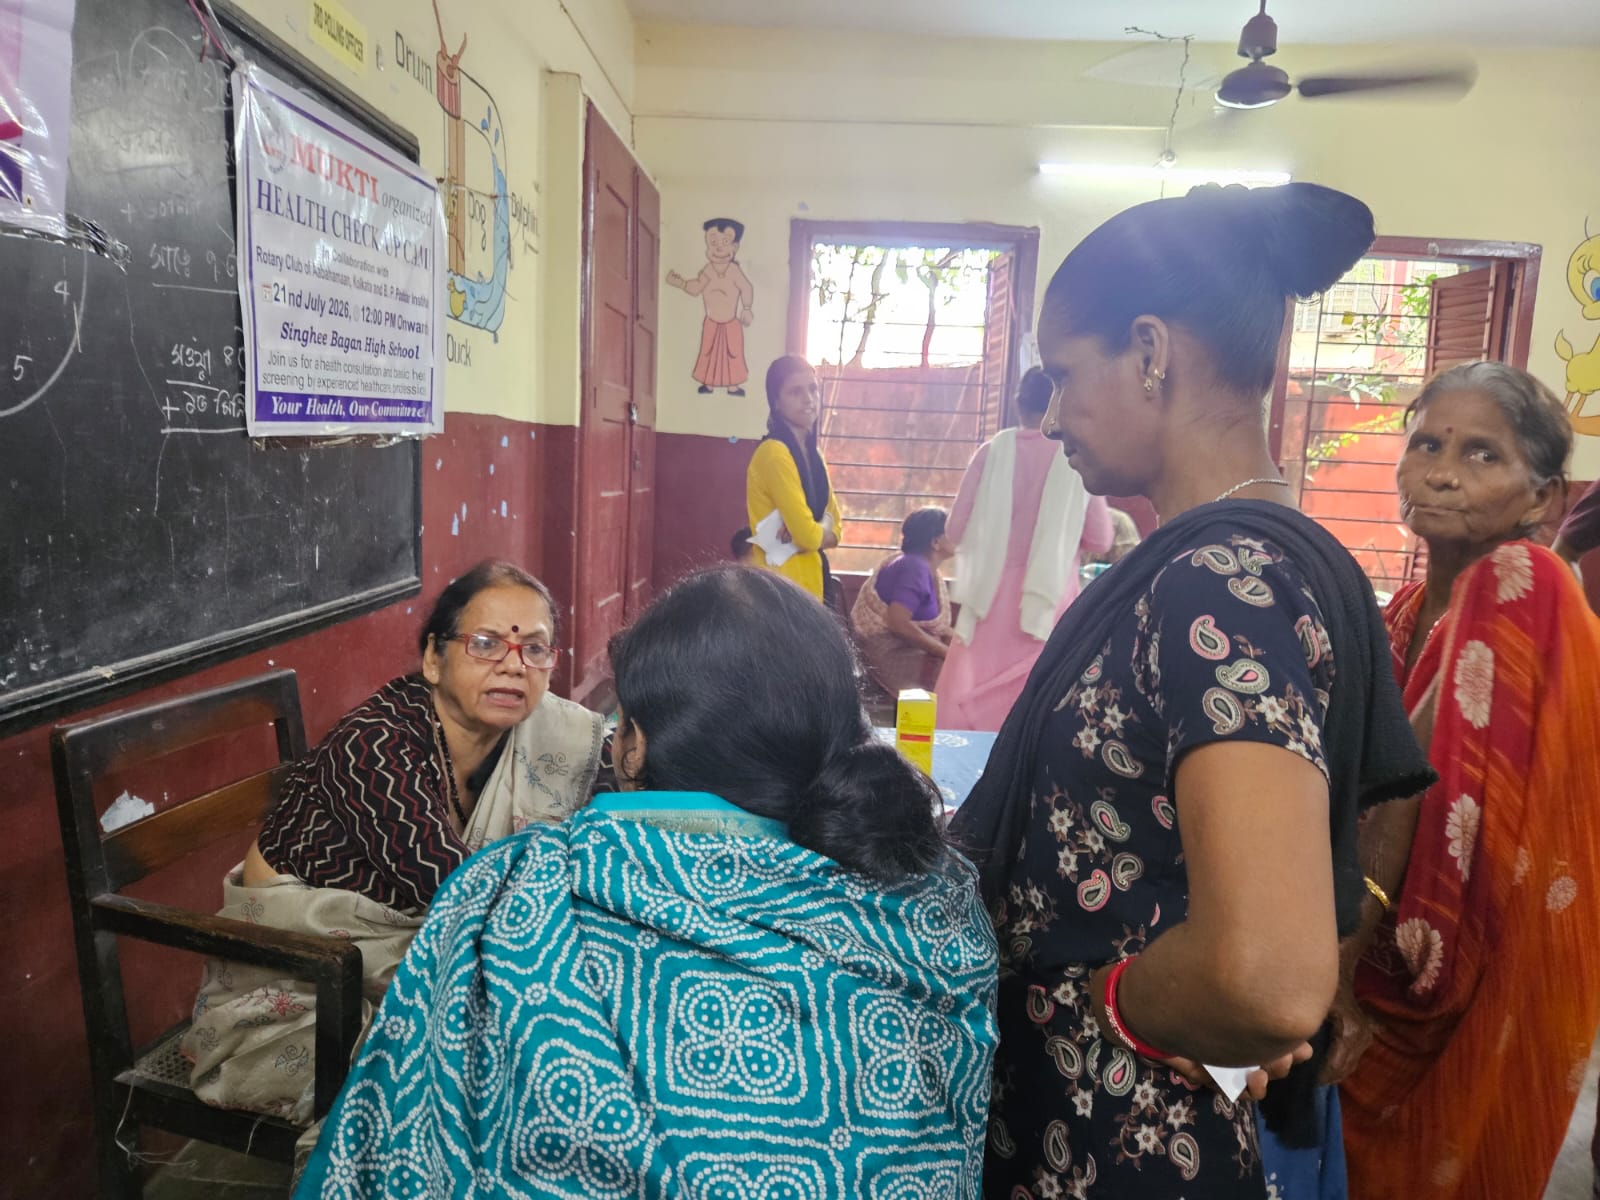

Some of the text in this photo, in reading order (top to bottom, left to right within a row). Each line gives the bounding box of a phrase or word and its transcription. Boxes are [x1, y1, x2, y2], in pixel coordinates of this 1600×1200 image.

[395, 30, 433, 94] Drum
[290, 133, 379, 205] MUKTI
[382, 191, 433, 227] organized
[257, 178, 327, 234] HEALTH
[468, 190, 487, 252] Dog
[256, 245, 283, 273] Rotary
[285, 253, 303, 273] Club
[304, 260, 311, 275] of
[332, 248, 375, 273] Collaboration
[53, 279, 71, 305] 4
[304, 291, 326, 318] July
[328, 296, 352, 321] 2026,
[361, 304, 383, 326] 12:00
[384, 311, 397, 329] PM
[280, 321, 420, 360] Singhee Bagan High School
[446, 334, 472, 367] Duck
[12, 354, 33, 381] 5
[267, 350, 286, 367] Join
[287, 355, 298, 369] us
[300, 353, 312, 370] for
[343, 361, 382, 377] consultation
[262, 372, 305, 391] screening
[271, 395, 303, 415] Your
[305, 396, 346, 419] Health,
[349, 399, 370, 417] Our
